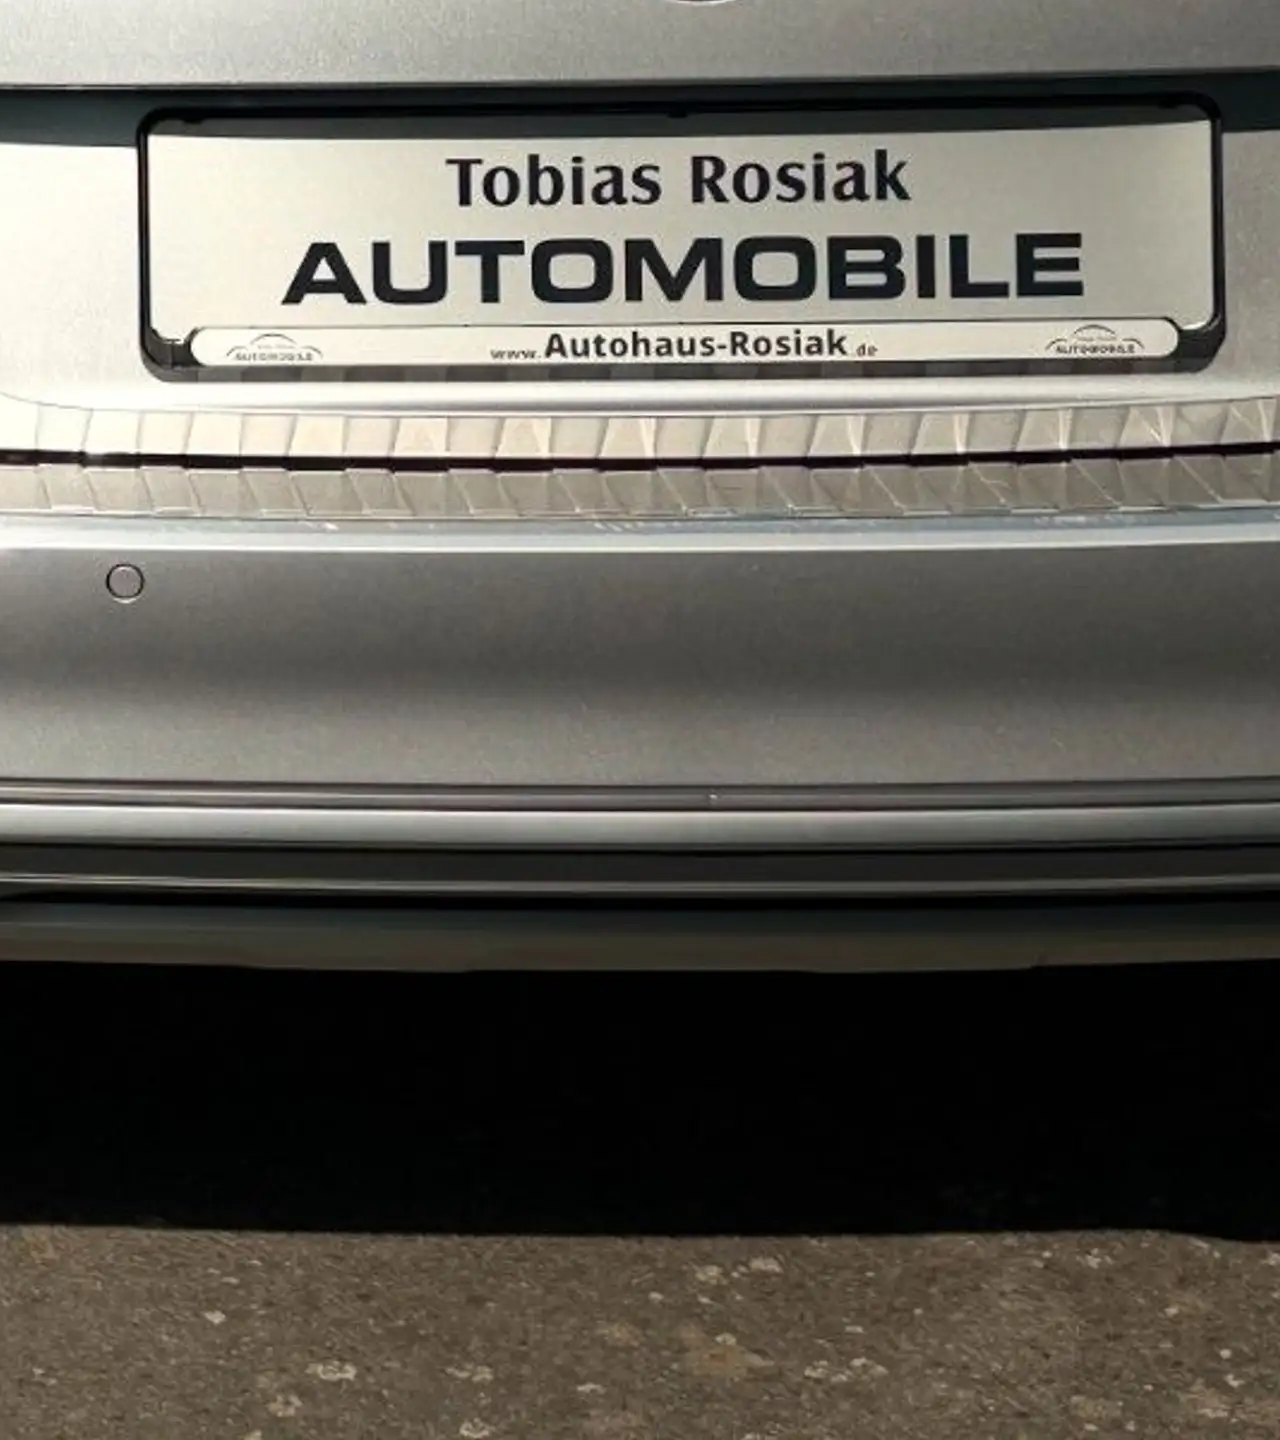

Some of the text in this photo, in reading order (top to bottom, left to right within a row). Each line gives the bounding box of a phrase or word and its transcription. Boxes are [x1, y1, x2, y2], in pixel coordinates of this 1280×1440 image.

[445, 149, 911, 207] Tobias Rosiak
[281, 232, 1085, 306] AUTOMOBILE
